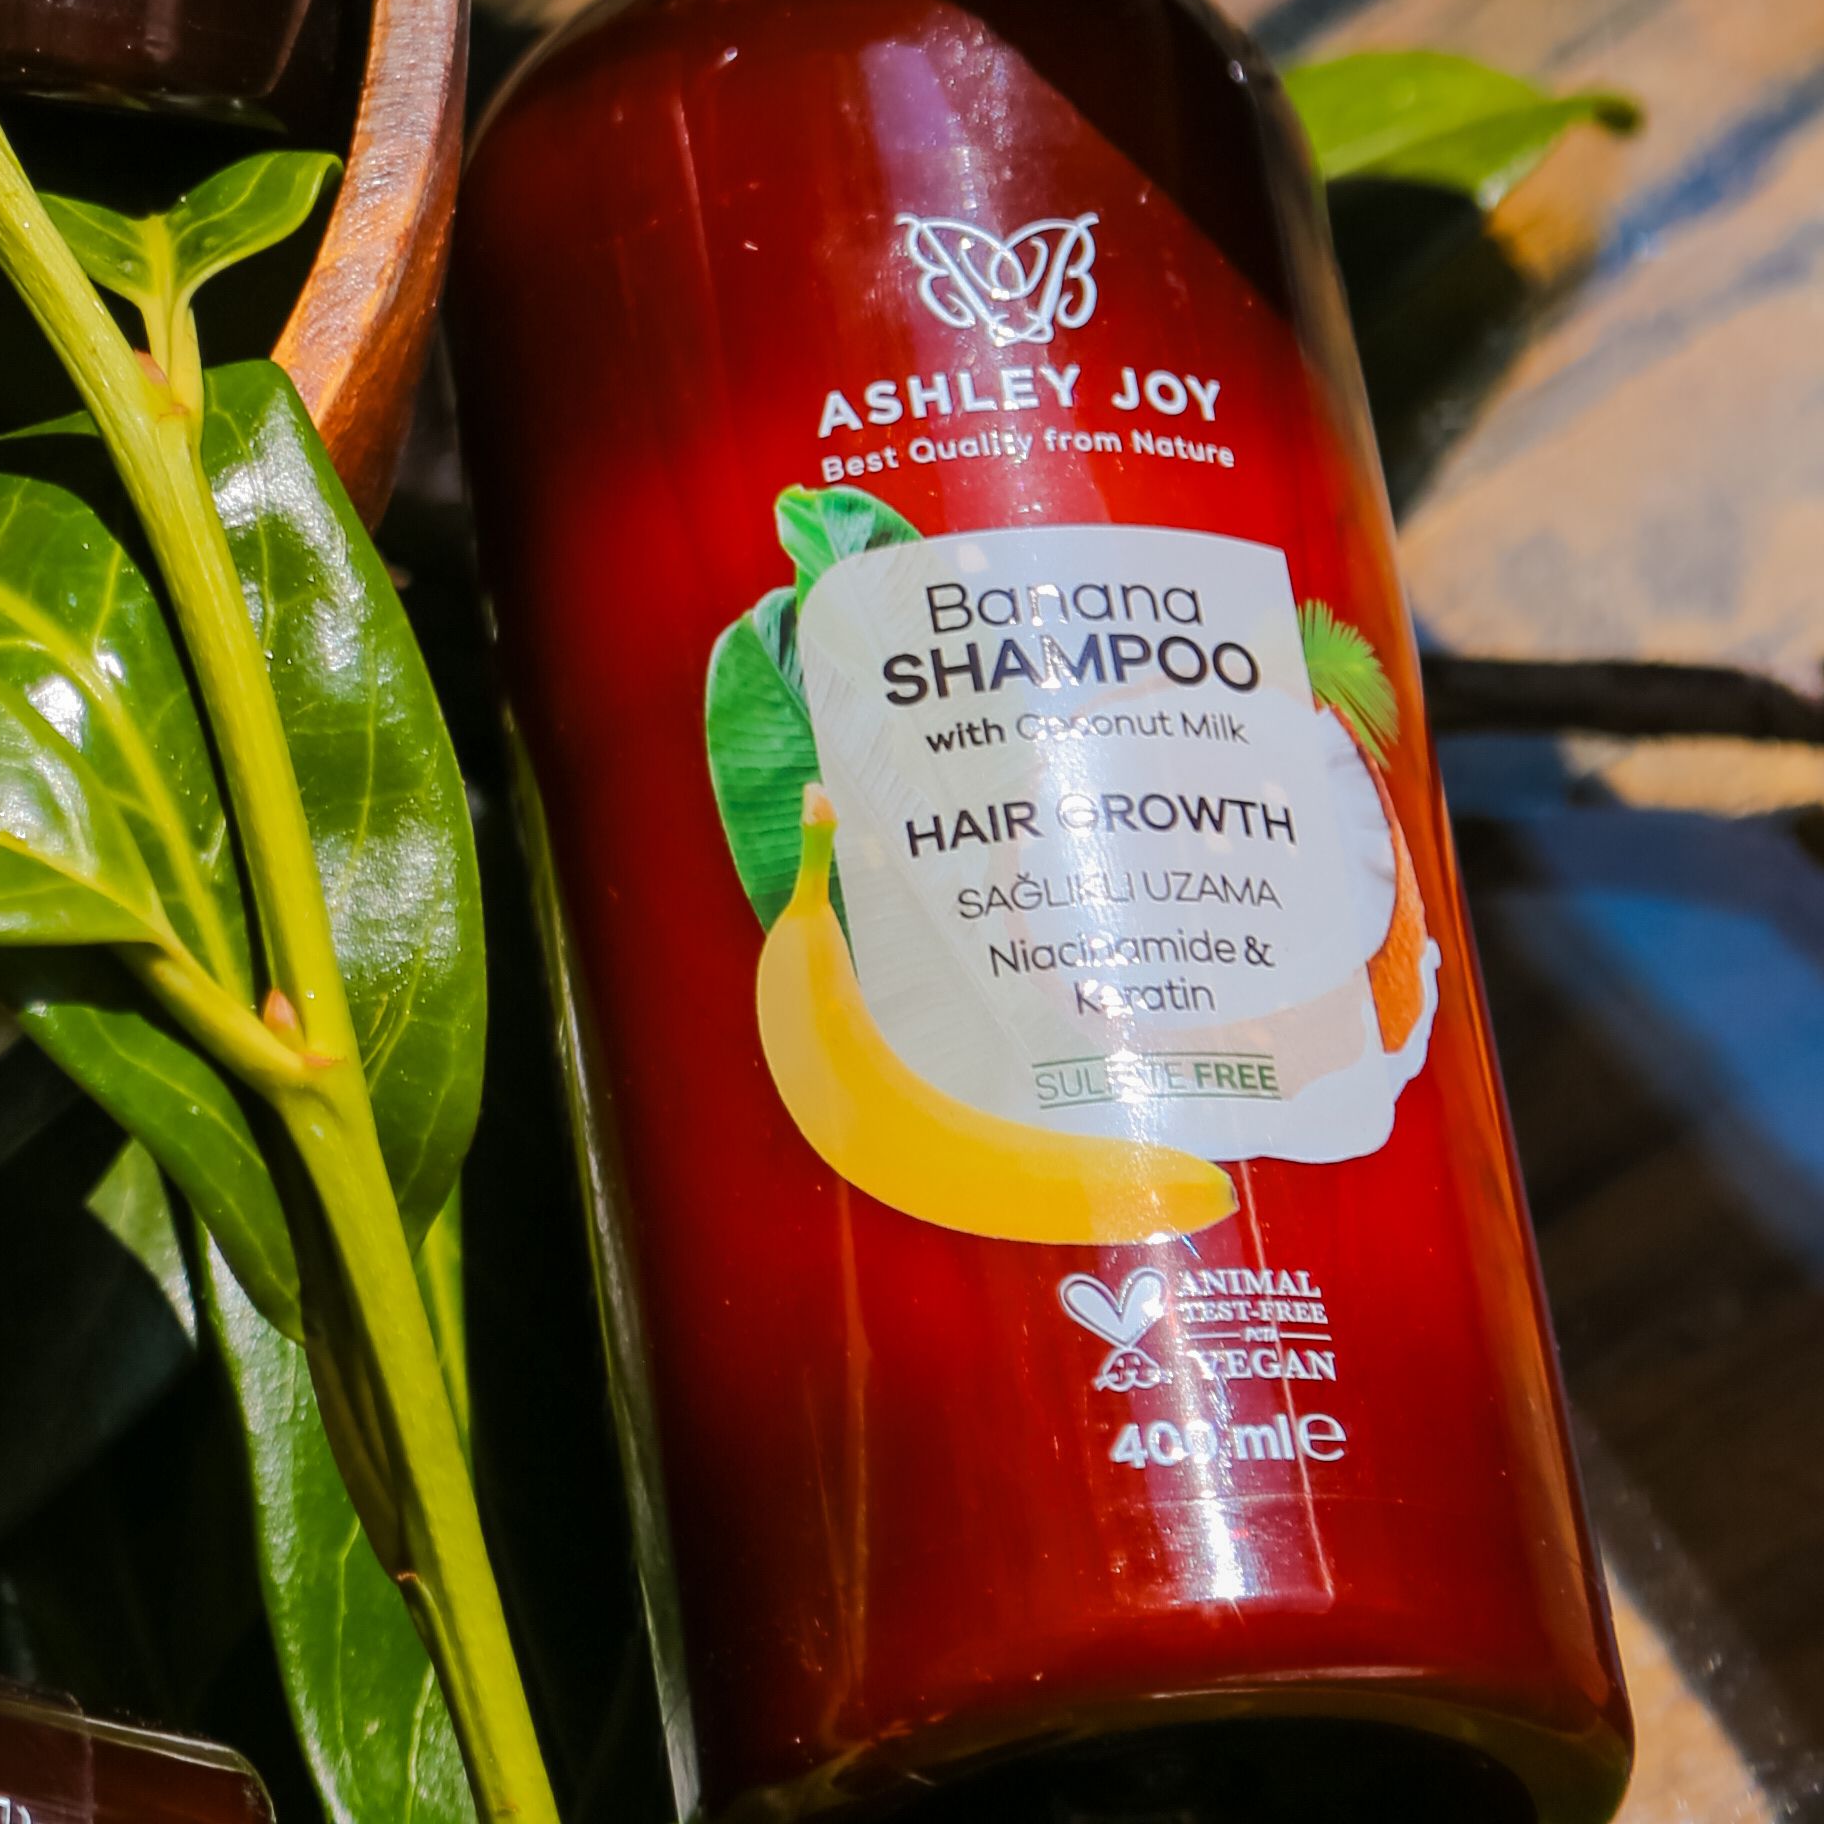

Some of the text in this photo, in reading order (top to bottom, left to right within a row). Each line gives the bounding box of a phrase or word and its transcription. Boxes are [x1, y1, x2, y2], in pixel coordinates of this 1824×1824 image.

[818, 364, 1221, 439] ASHLEY JOY
[821, 446, 900, 483] Best
[1044, 427, 1123, 453] from
[1130, 428, 1236, 468] Nature
[925, 583, 1204, 634] Banana
[881, 633, 1260, 707] SHAMPOO
[926, 717, 1005, 754] with
[1181, 712, 1250, 745] Milk
[906, 793, 1298, 859] HAIR GROWTH
[1143, 871, 1283, 910] UZAMA
[1243, 935, 1276, 968] &
[1074, 977, 1217, 1016] Kratin
[1034, 1061, 1279, 1101] SULTE FREE
[1176, 1268, 1322, 1298] ANIMAL
[1177, 1299, 1329, 1325] TEST-FREE
[1185, 1348, 1337, 1381] VEGAN
[1110, 1418, 1218, 1469] 400
